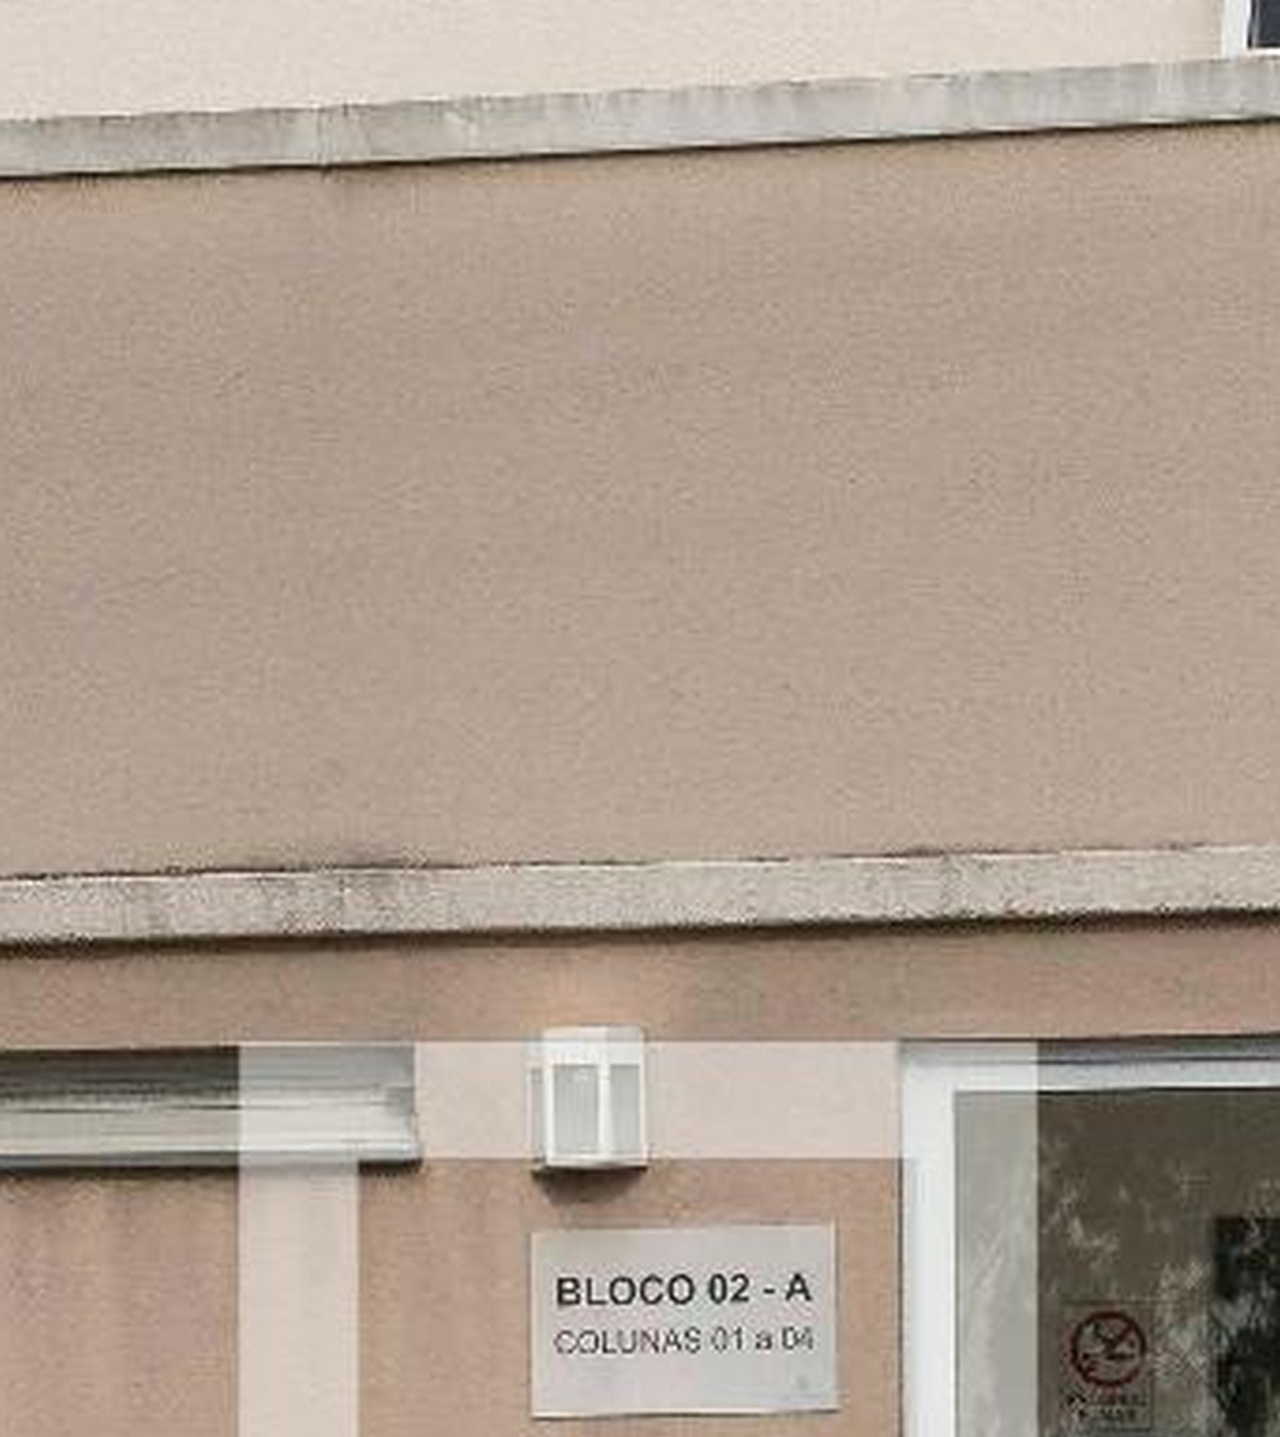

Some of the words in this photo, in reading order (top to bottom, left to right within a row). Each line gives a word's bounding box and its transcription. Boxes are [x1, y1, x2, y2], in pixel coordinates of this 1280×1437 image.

[556, 1273, 696, 1306] BLOCO
[707, 1272, 750, 1305] 02
[785, 1271, 812, 1302] A
[553, 1326, 702, 1355] COLUNAS
[710, 1325, 744, 1351] 01
[755, 1331, 773, 1351] a
[781, 1325, 814, 1351] 04
